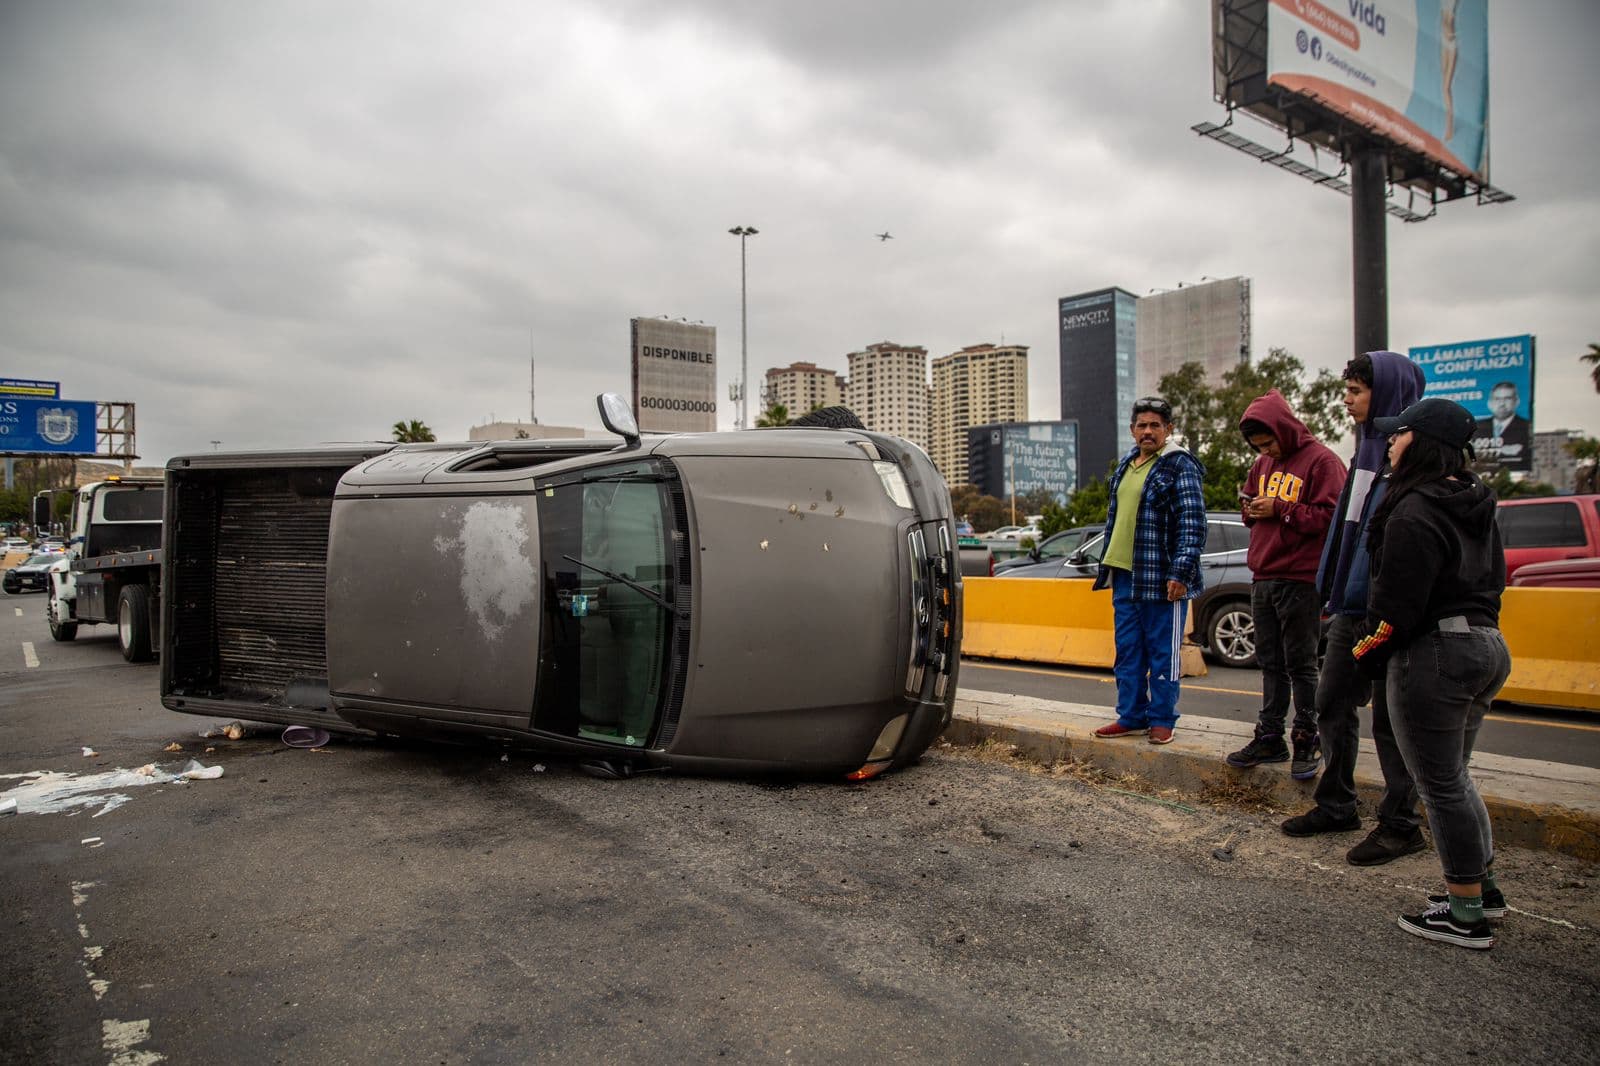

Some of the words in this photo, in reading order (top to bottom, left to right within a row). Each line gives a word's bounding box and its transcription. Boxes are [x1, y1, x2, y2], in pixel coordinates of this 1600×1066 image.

[1348, 0, 1385, 36] Vida
[643, 345, 713, 364] DISPONIBLE
[1488, 342, 1522, 356] CON
[1434, 354, 1525, 374] CONFIANZA!
[641, 396, 717, 413] 8000030000
[1015, 442, 1033, 456] The
[1035, 443, 1065, 457] future
[1023, 455, 1061, 468] Medical
[1030, 467, 1067, 480] Tourism
[1044, 479, 1066, 492] here
